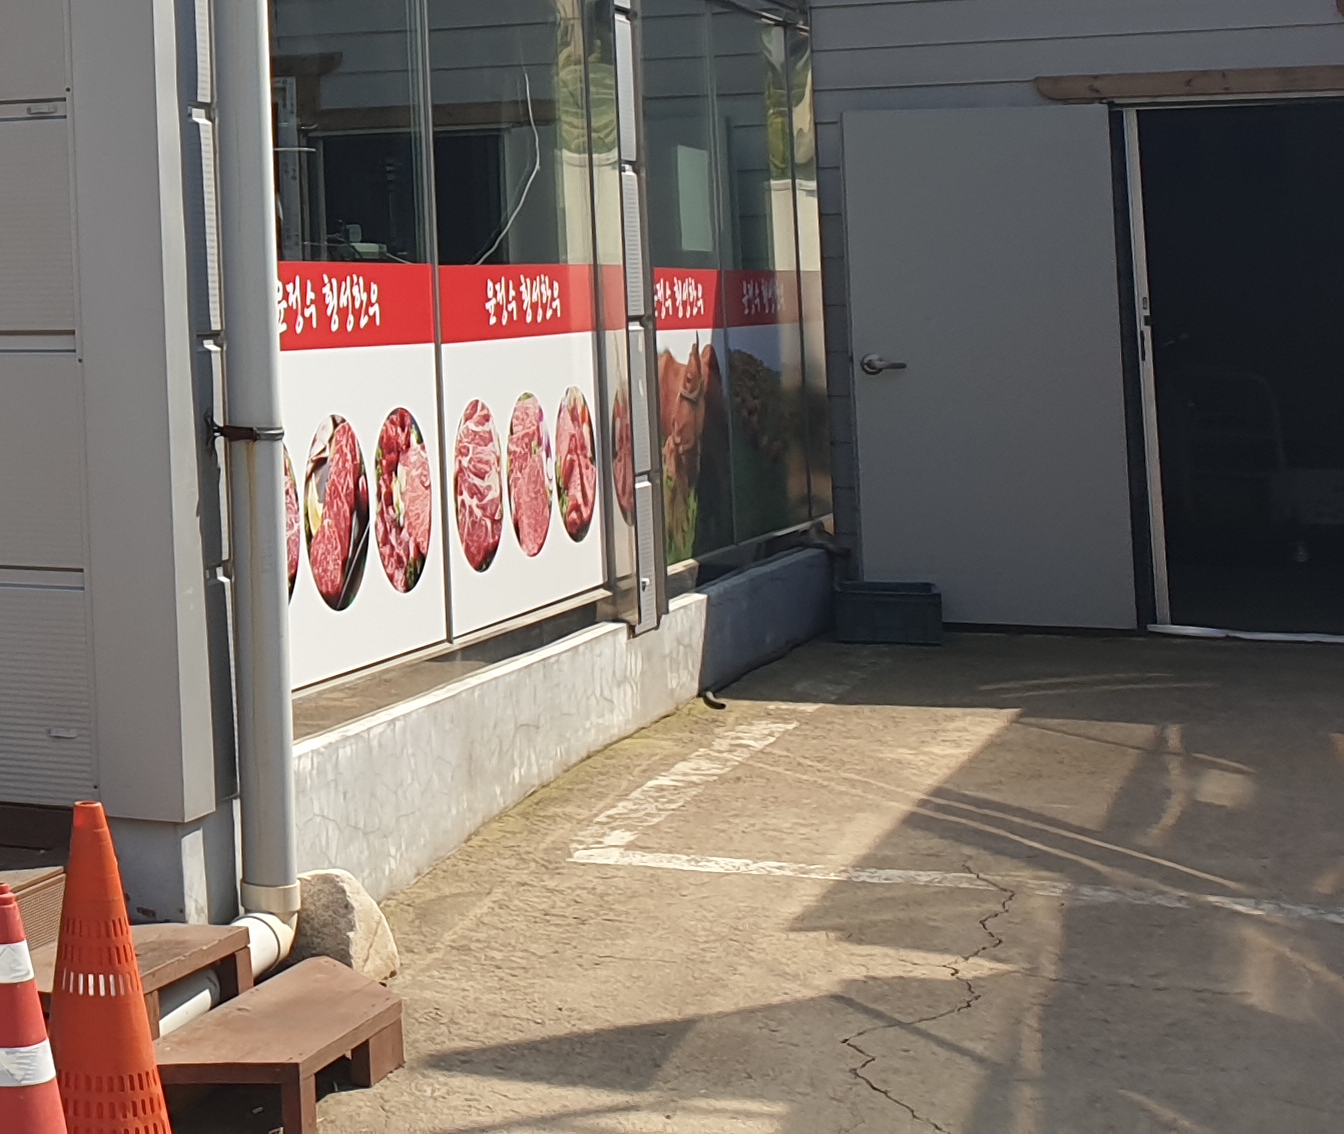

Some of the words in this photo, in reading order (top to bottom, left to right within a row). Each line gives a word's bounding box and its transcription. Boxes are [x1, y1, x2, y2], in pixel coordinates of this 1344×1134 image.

[322, 273, 381, 332] 횡성한우
[485, 276, 517, 326] 윤정수
[519, 274, 561, 324] 횡성한우
